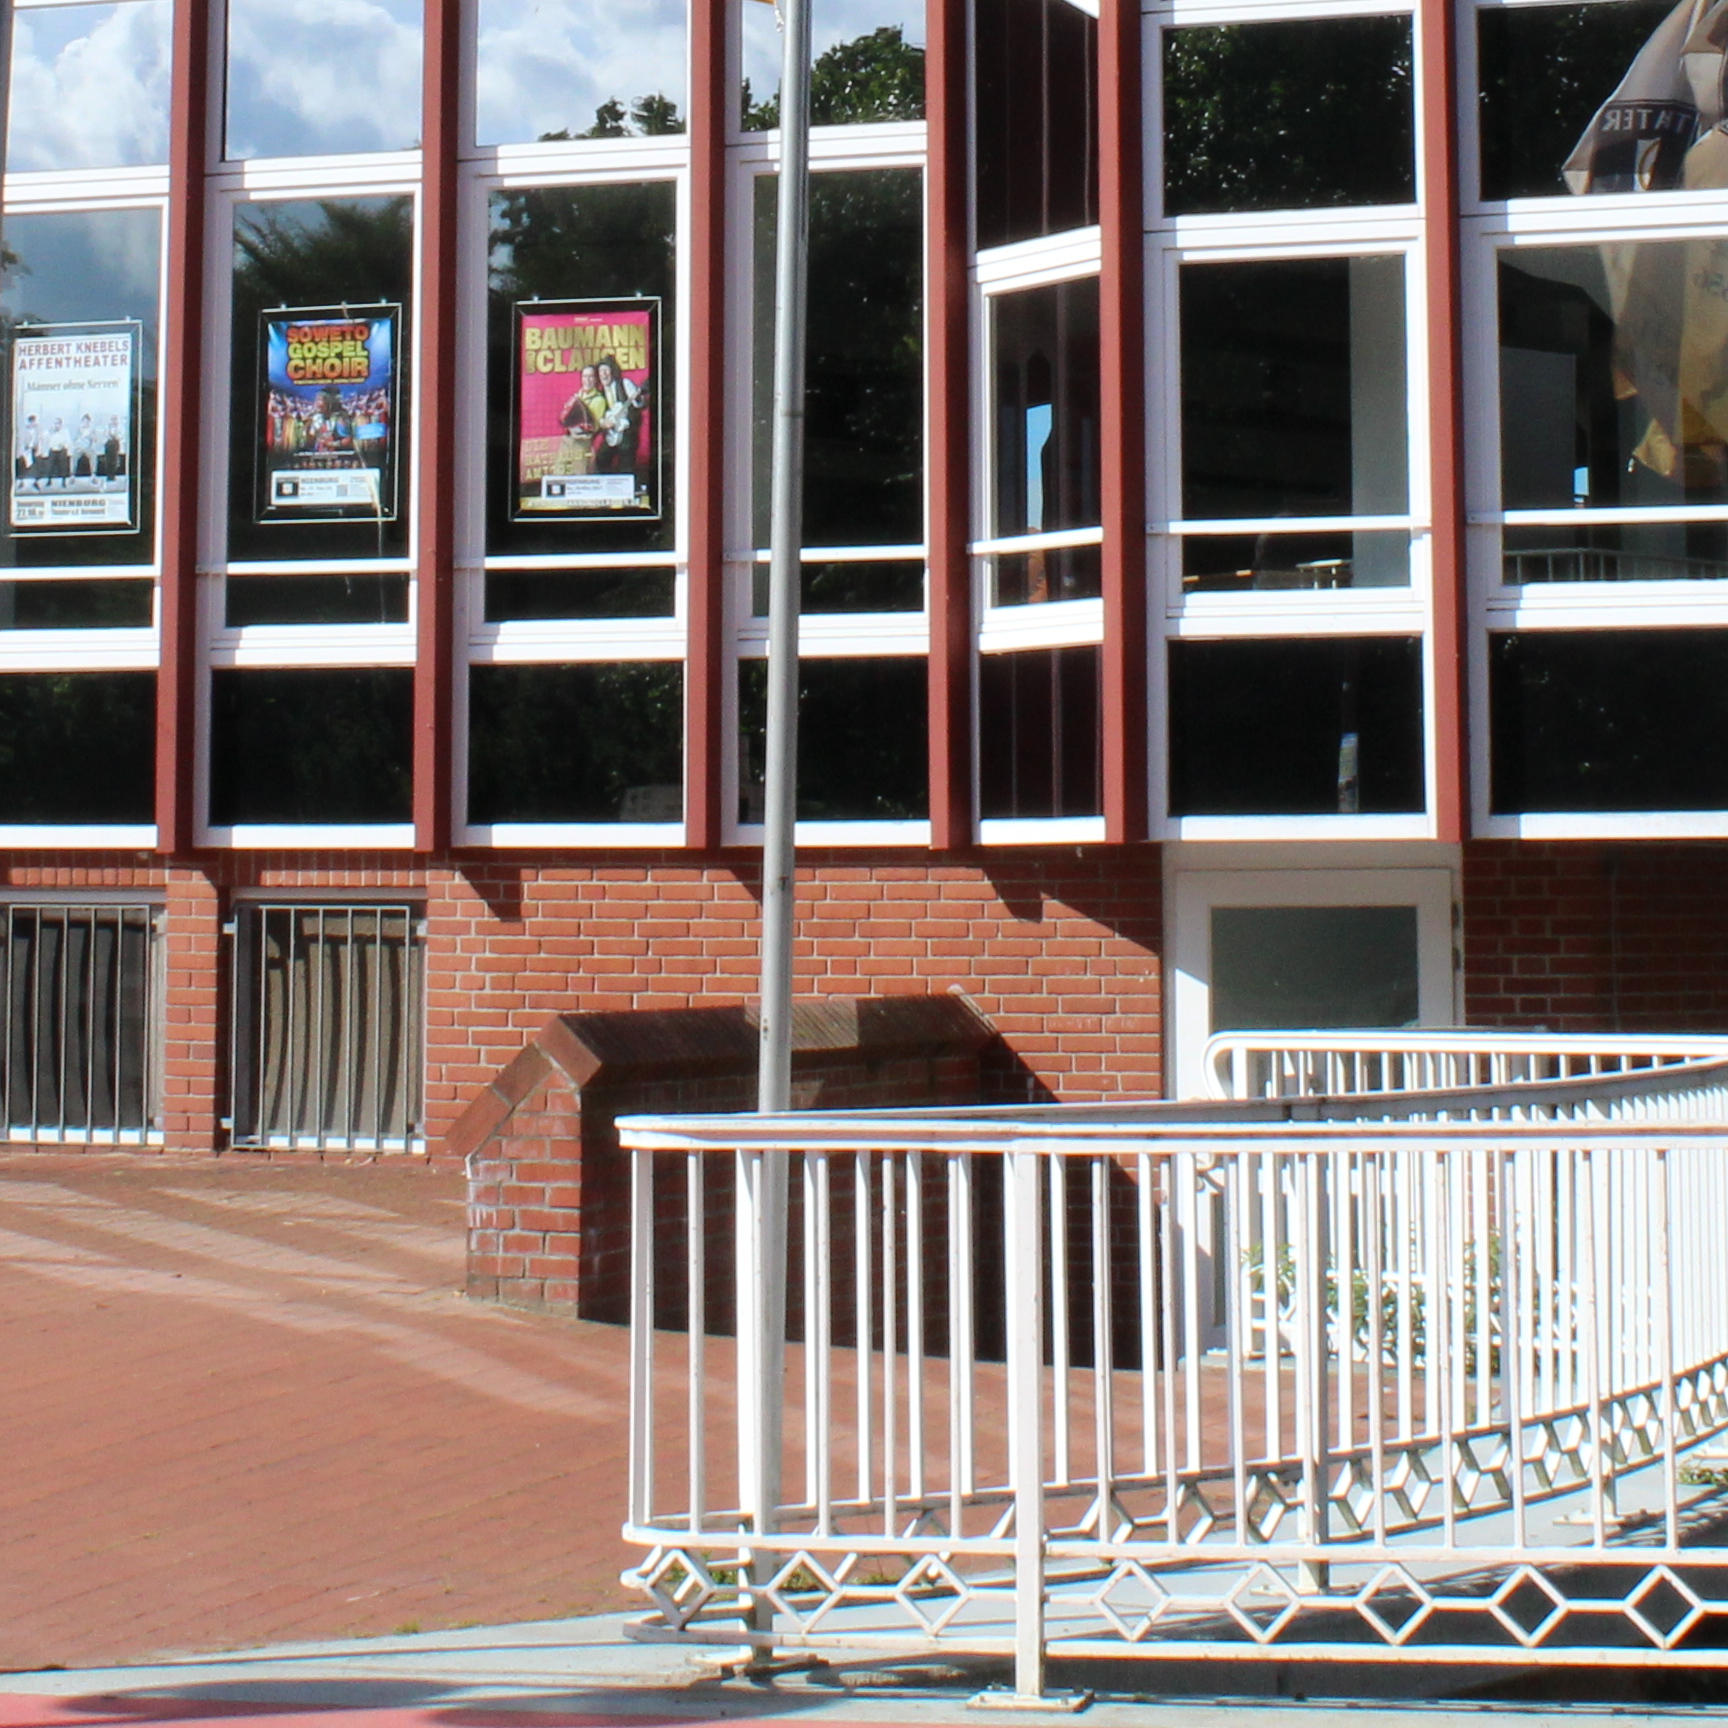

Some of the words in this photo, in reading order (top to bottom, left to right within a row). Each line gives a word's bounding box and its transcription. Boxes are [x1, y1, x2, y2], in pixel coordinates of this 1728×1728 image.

[286, 324, 369, 344] SOWETO
[525, 323, 647, 350] BAUMANN
[18, 342, 72, 357] HERBERT
[75, 340, 129, 354] KNEBELS
[287, 340, 369, 359] GOSPEL
[18, 354, 128, 371] AFFENTHEATER
[286, 357, 369, 379] CHOIR
